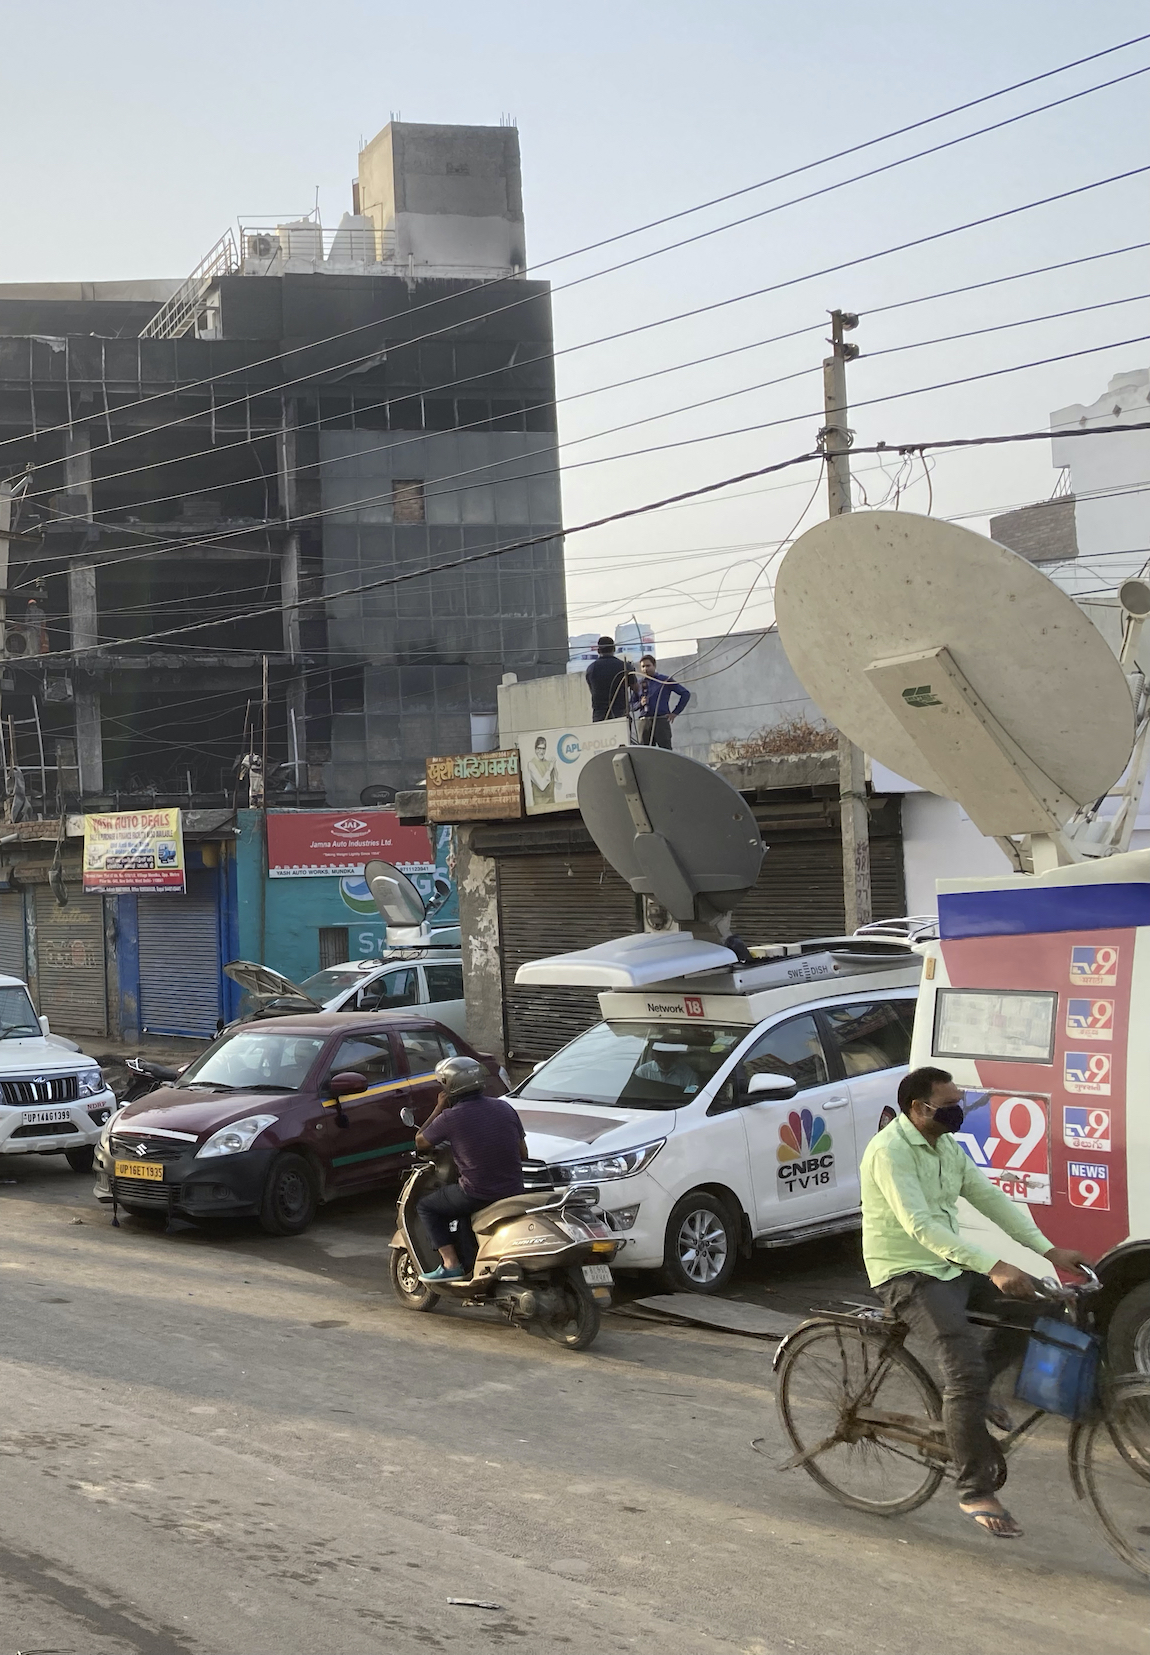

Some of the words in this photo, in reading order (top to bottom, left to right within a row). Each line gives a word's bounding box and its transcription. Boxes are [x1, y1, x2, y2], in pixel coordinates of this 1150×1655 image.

[566, 744, 581, 754] APL
[581, 738, 617, 751] APOLLO
[115, 815, 139, 830] AUTO
[141, 814, 169, 828] DEALS
[310, 841, 331, 849] Jamna
[1072, 948, 1117, 975] TV9
[647, 1003, 685, 1014] Network
[687, 1001, 701, 1014] 18
[1068, 1001, 1113, 1028] TV9
[1066, 1055, 1110, 1083] TV9
[87, 1101, 107, 1110] NDRF
[1065, 1110, 1109, 1138] TV9
[1072, 1138, 1103, 1150] తెలుగు
[120, 1164, 162, 1178] UP16ET1935
[778, 1154, 834, 1179] CNBC
[1071, 1164, 1106, 1179] NEWS
[785, 1171, 830, 1192] TV18
[1078, 1179, 1100, 1206] 9
